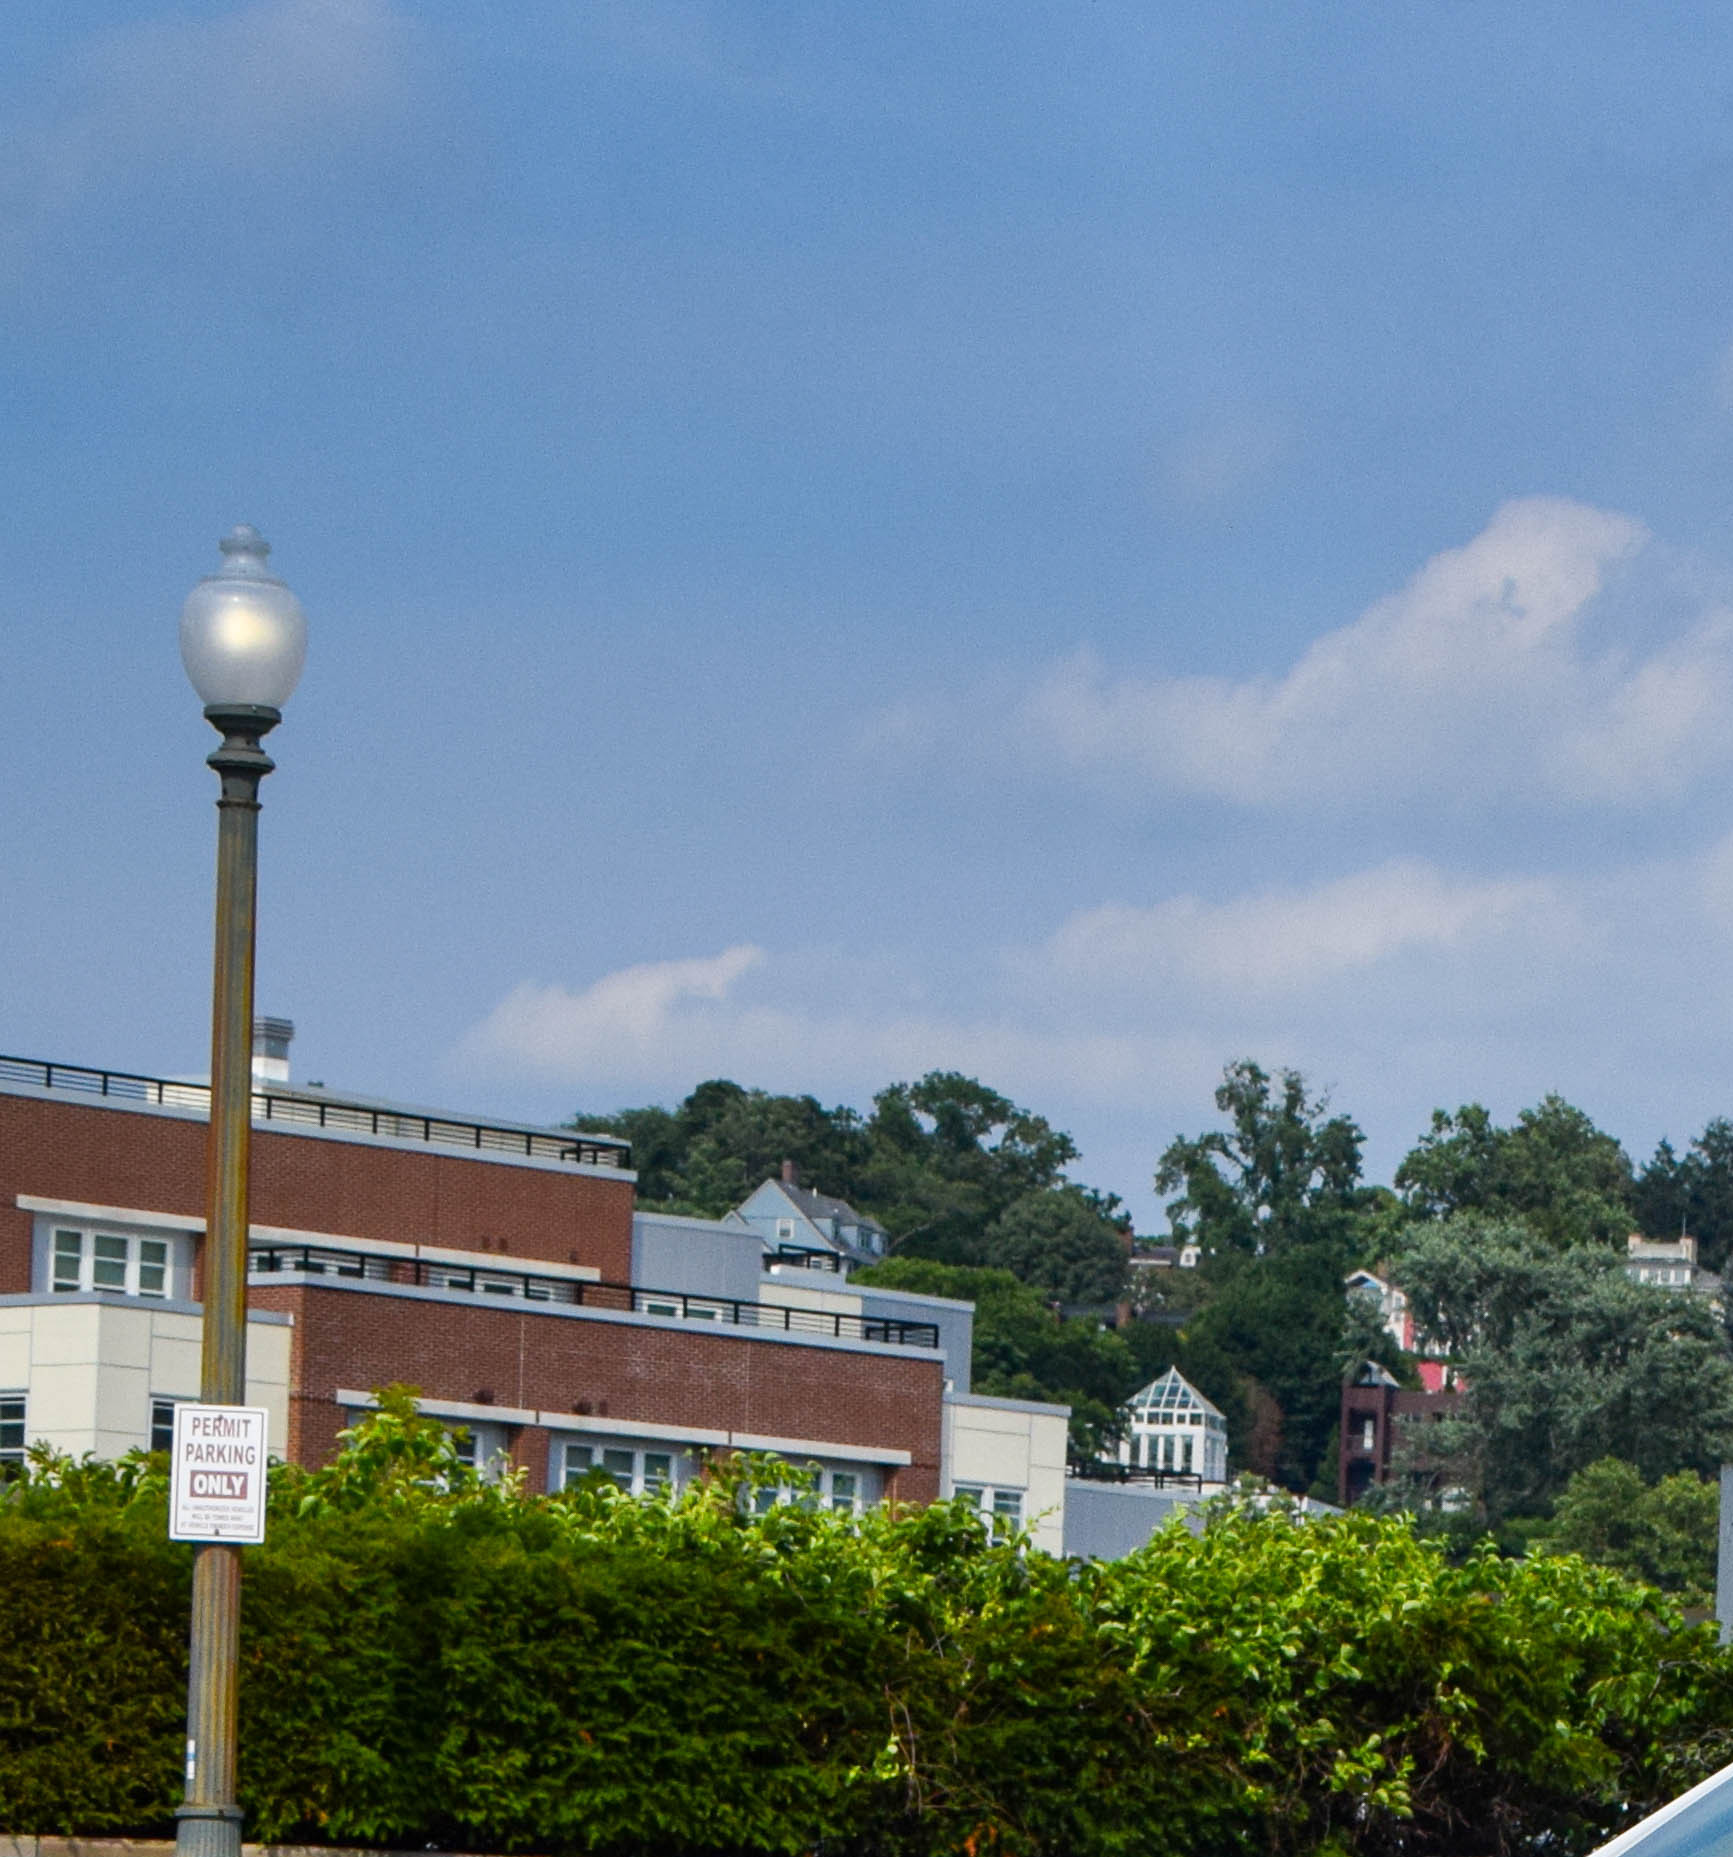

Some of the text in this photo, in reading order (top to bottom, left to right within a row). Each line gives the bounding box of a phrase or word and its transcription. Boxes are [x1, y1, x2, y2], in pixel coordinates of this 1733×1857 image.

[192, 1416, 251, 1438] PERMIT
[186, 1443, 256, 1466] PARKING
[193, 1473, 245, 1497] ONLY
